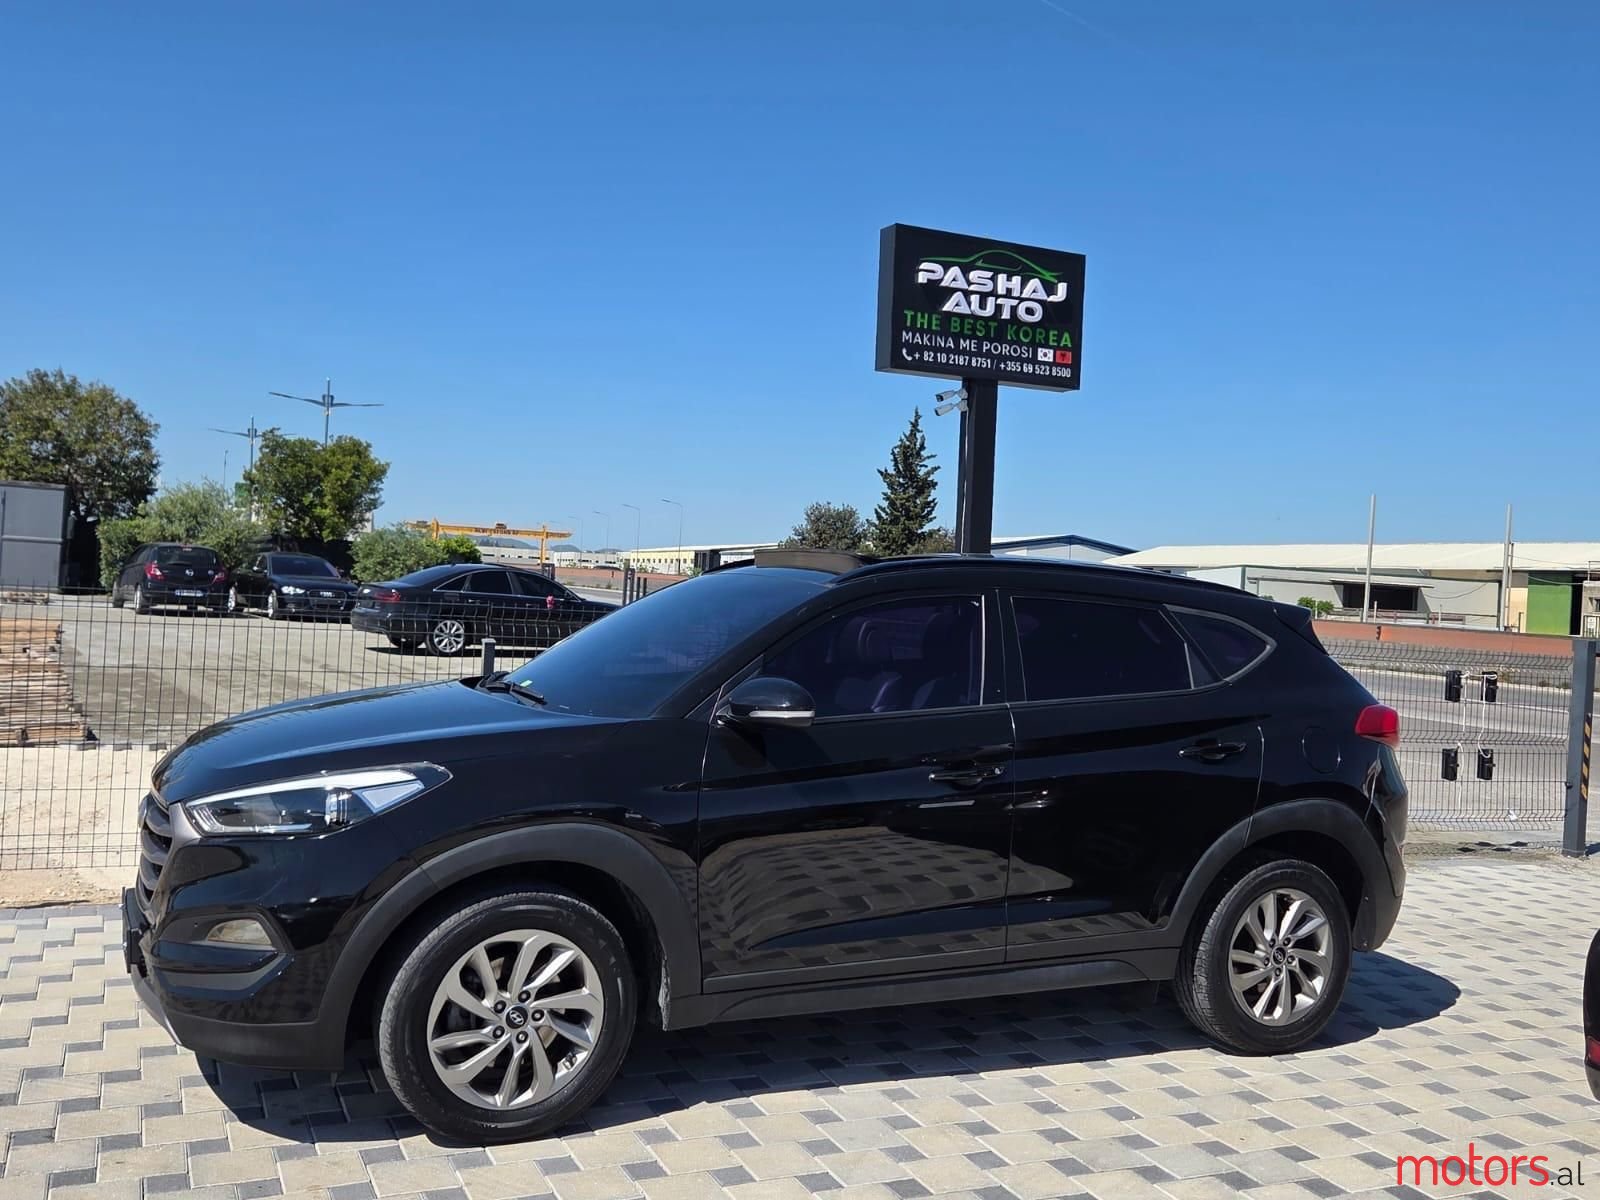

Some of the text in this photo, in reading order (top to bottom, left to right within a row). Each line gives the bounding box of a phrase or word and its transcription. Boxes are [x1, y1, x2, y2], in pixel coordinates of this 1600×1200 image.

[917, 261, 1068, 302] PASHAJ
[942, 291, 1043, 322] AUTO
[902, 329, 1032, 359] MAKINA ME POROSI
[904, 309, 1072, 348] THE BEST KOREA
[923, 350, 935, 362] 82
[937, 352, 947, 364] 10
[949, 353, 970, 367] 2187
[971, 356, 991, 369] 8751
[999, 361, 1021, 372] +355
[1023, 362, 1033, 374] 69
[1034, 364, 1050, 376] 523
[1051, 366, 1072, 378] 8500
